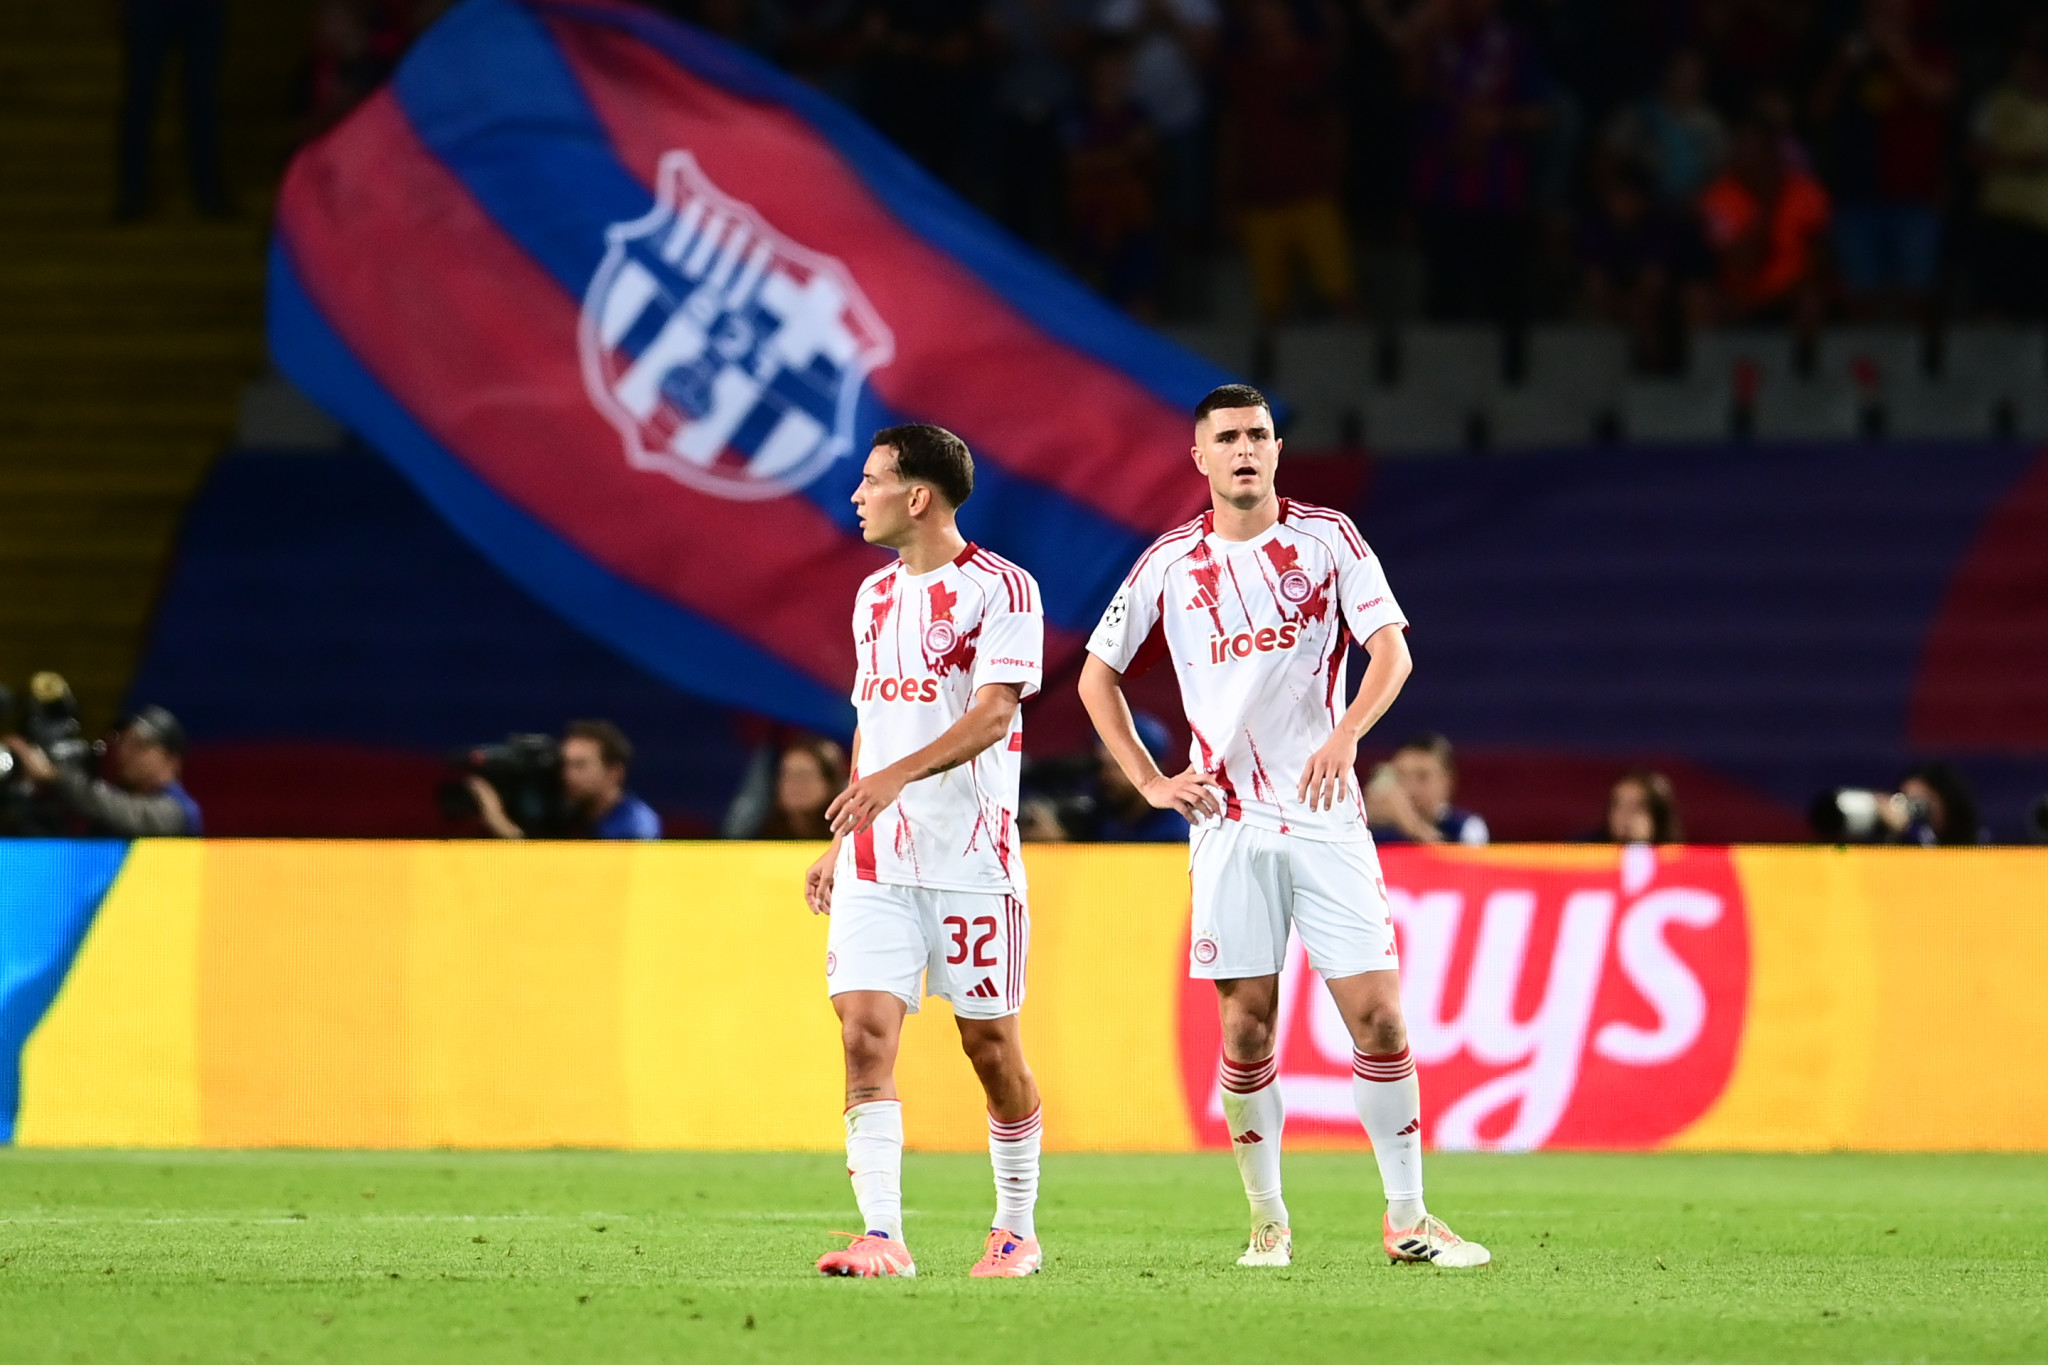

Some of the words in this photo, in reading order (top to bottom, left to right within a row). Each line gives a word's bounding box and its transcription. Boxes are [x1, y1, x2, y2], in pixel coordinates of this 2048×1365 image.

[1211, 623, 1299, 664] iroes
[861, 671, 938, 703] iroes
[943, 914, 997, 968] 32
